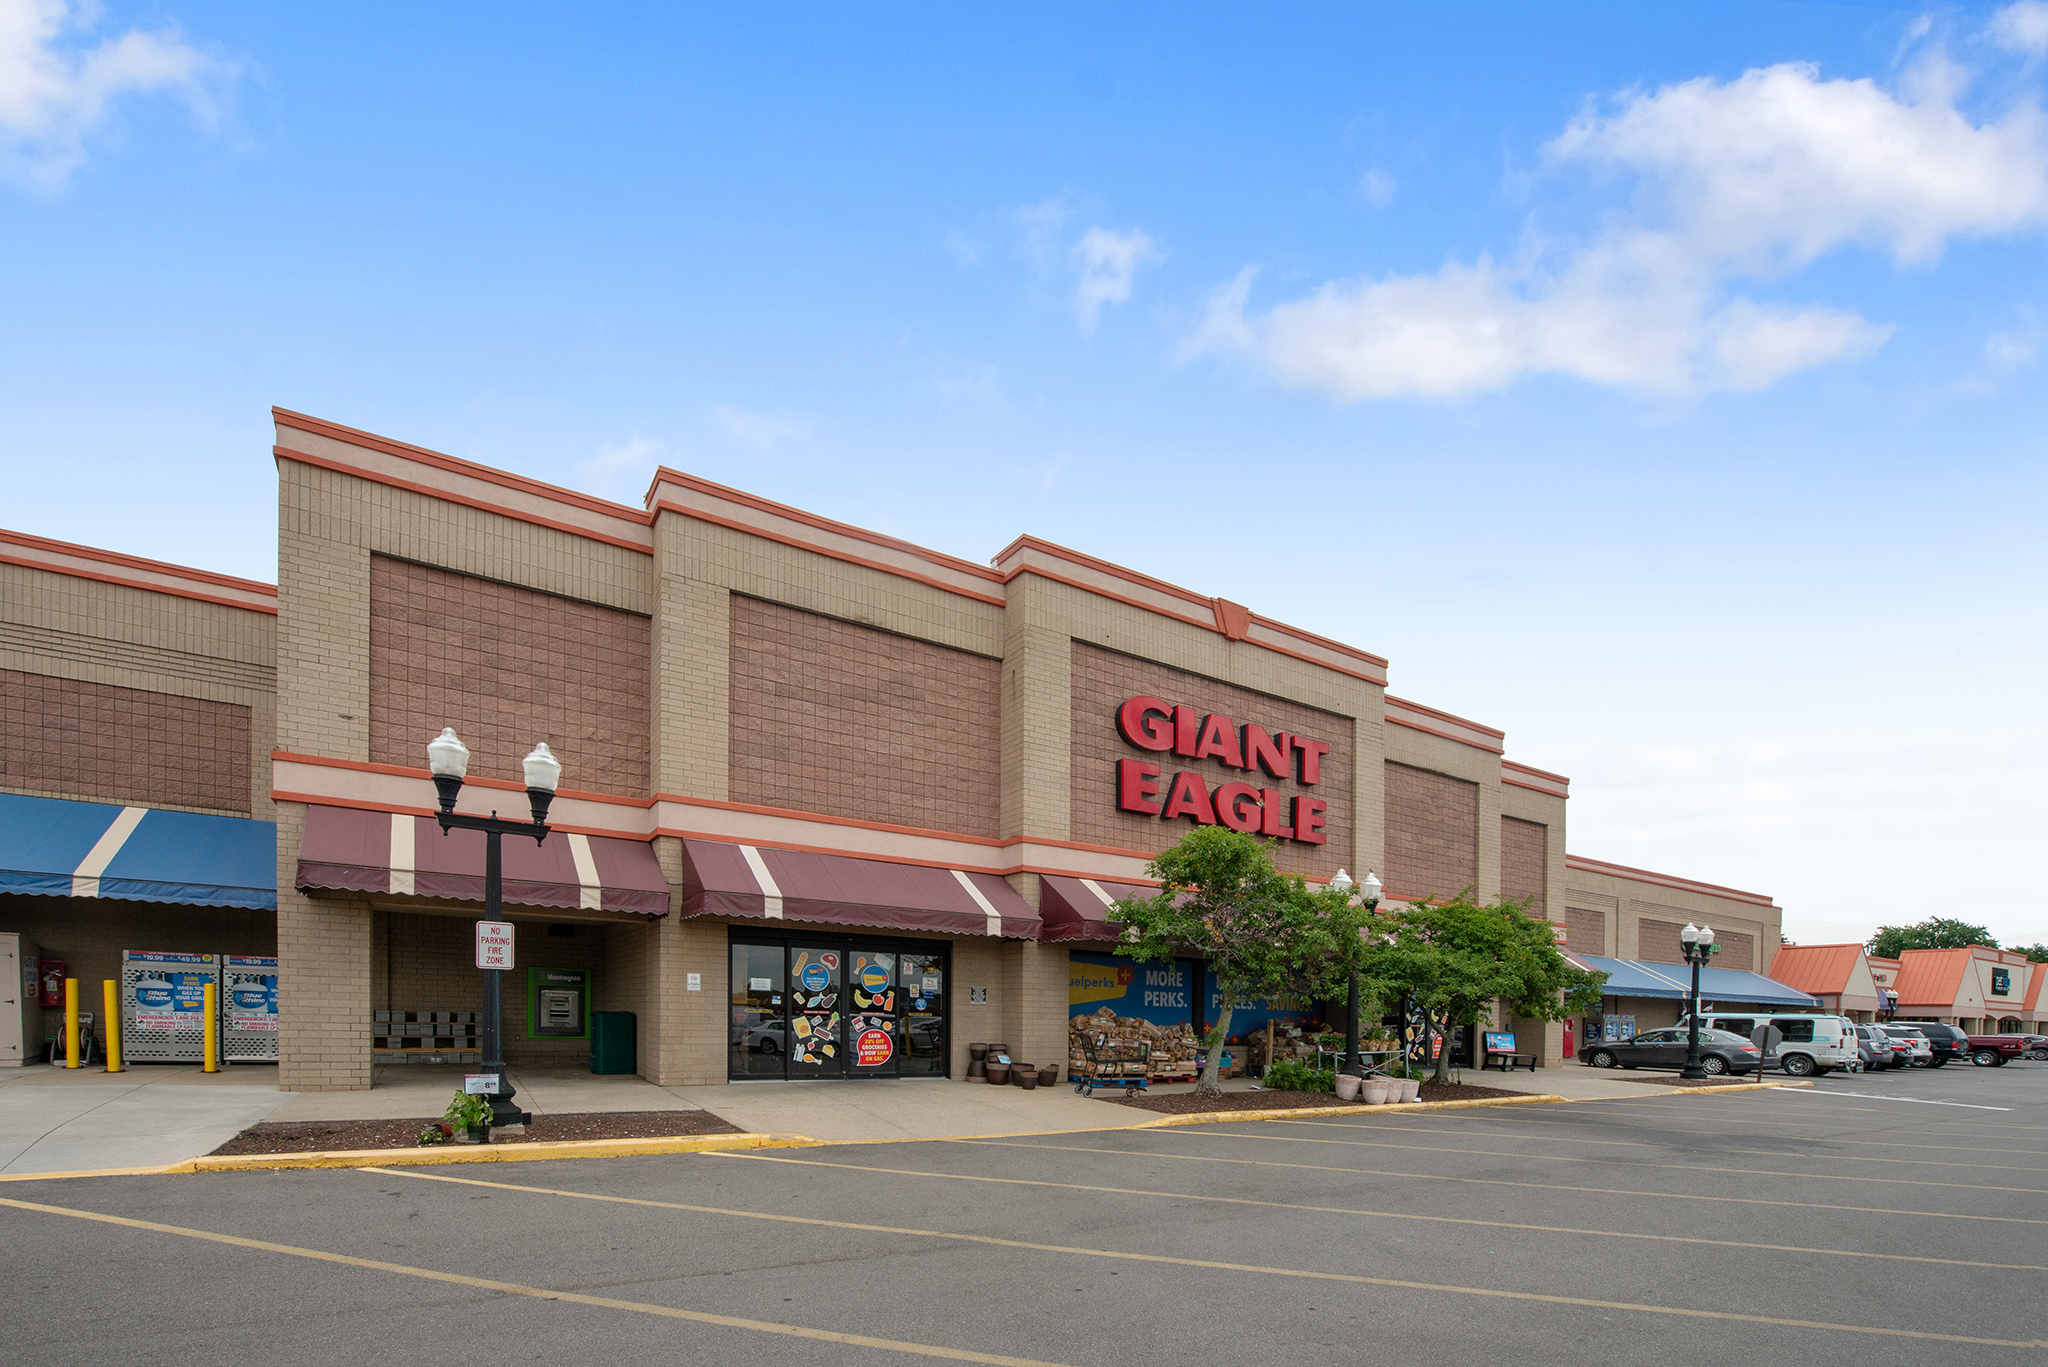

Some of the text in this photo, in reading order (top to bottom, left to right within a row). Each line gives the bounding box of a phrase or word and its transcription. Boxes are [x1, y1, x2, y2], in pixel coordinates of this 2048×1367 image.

[1116, 695, 1329, 785] GIANT
[1116, 758, 1327, 845] EAGLE
[490, 927, 500, 935] NO
[480, 936, 510, 946] PARKING
[488, 946, 502, 955] FIRE
[486, 956, 504, 964] ZONE
[548, 974, 580, 982] Huntington
[1069, 976, 1115, 990] uelperks
[1146, 970, 1183, 987] MORE
[1144, 991, 1188, 1008] PERKS.
[1212, 994, 1256, 1010] PCES.
[1266, 996, 1313, 1012] SAVINGS.
